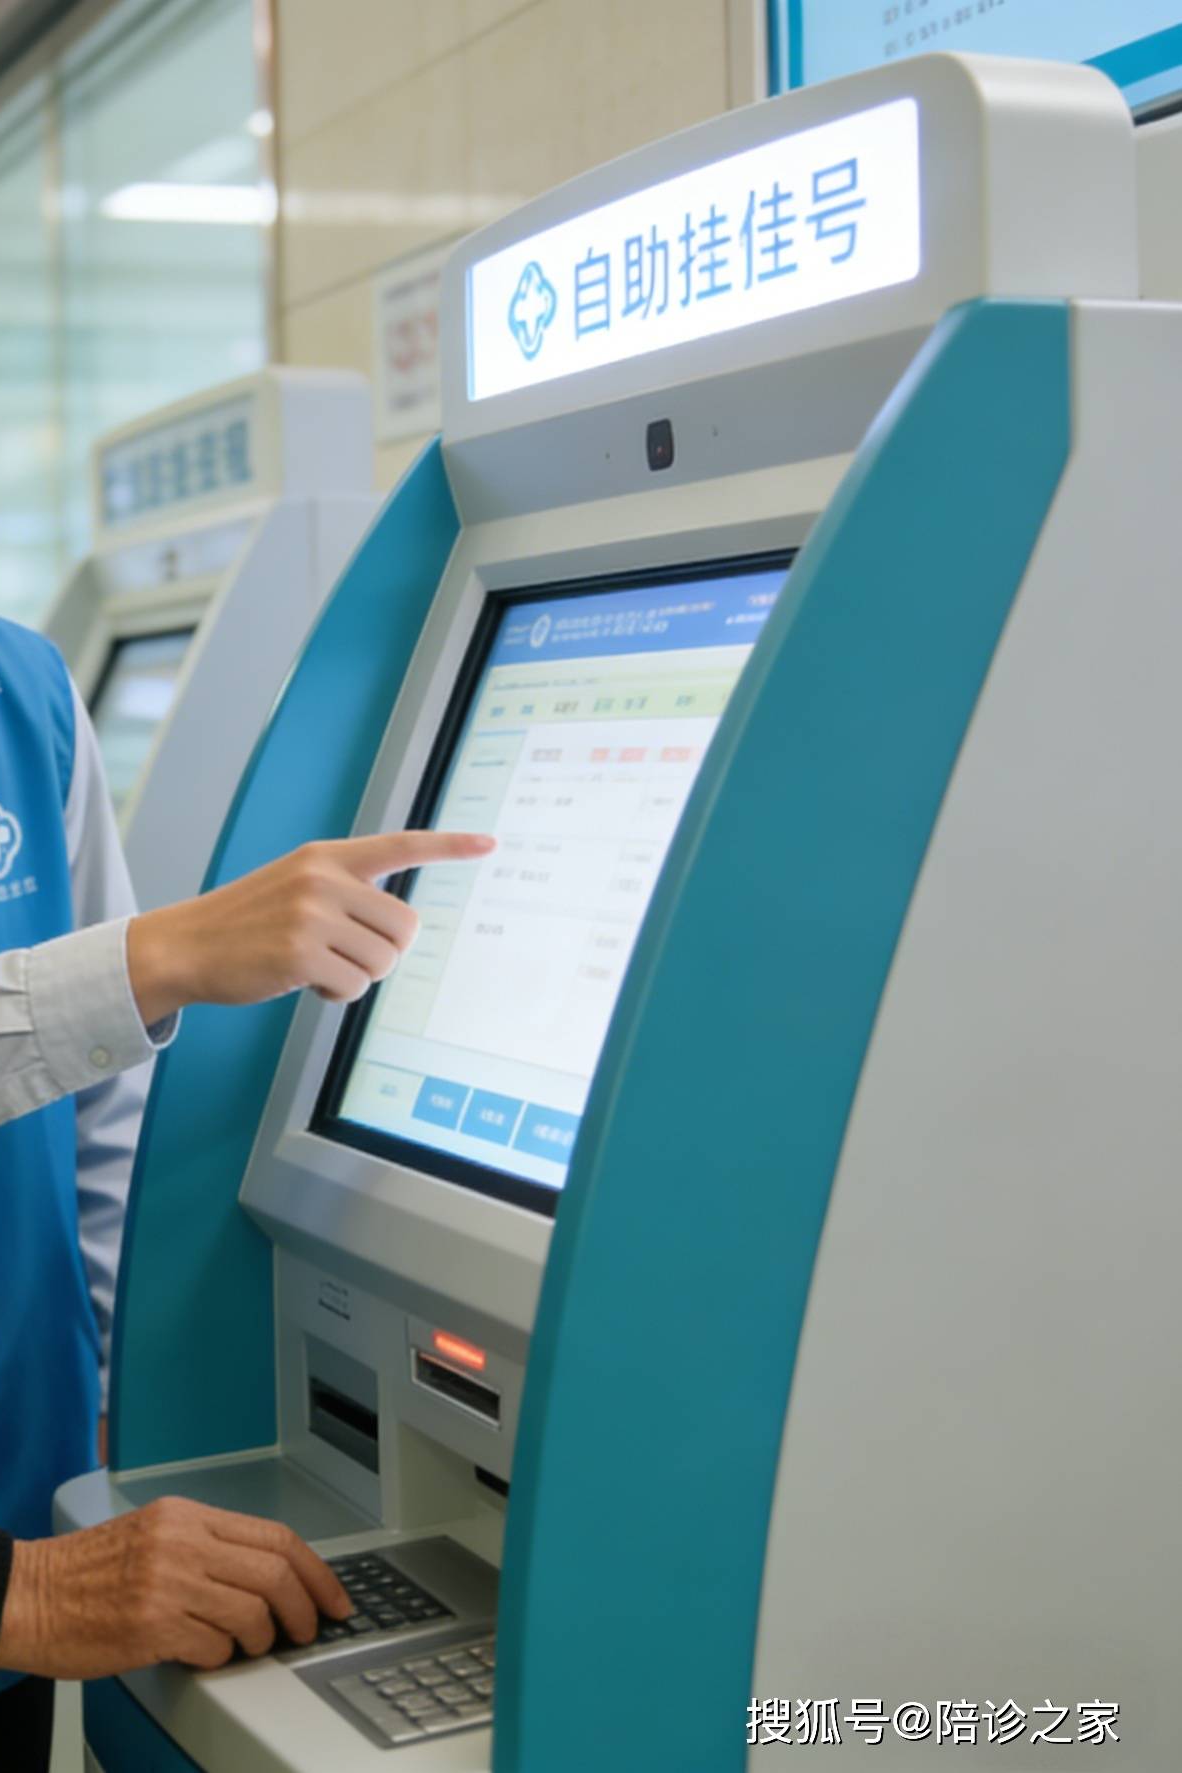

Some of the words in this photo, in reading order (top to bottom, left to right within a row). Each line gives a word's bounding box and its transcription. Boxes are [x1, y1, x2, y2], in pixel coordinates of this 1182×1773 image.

[574, 157, 867, 341] 自助挂佳号
